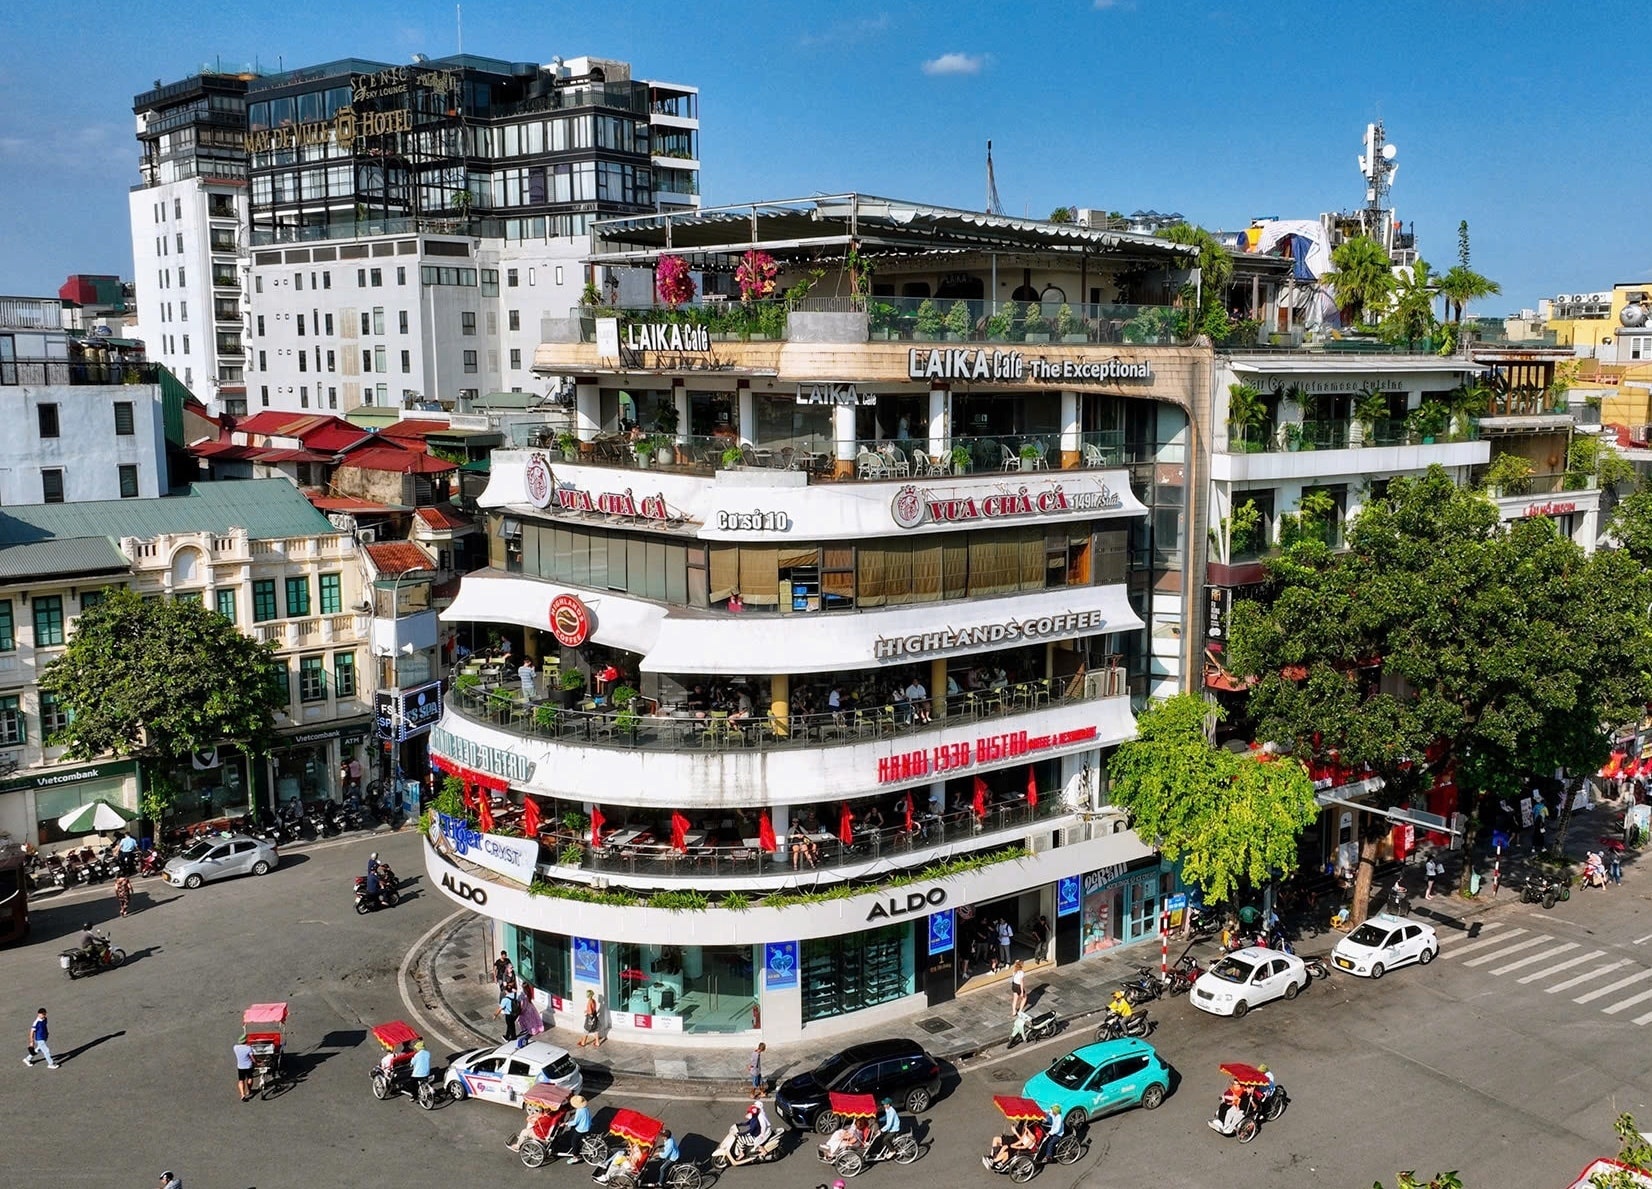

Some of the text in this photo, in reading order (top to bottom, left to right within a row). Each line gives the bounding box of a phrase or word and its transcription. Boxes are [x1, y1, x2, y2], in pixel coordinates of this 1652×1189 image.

[350, 66, 408, 91] SCENIC
[366, 84, 408, 99] SKY LOUNGE
[243, 108, 413, 154] MAY DE VILLE HOTEL
[628, 323, 709, 351] LAIKA Café
[908, 348, 1151, 381] LAIKA Café The Exceptional
[796, 383, 860, 405] LAIKA
[558, 488, 596, 513] VUA
[598, 487, 638, 517] CHẢ
[928, 496, 979, 522] VUA
[981, 485, 1034, 517] CHẢ
[765, 511, 787, 531] 10
[550, 598, 585, 623] HIGHLANDS
[555, 630, 583, 644] COFFEE
[875, 610, 1101, 658] HIGHLANDS COFFEE
[379, 717, 392, 728] SP
[381, 704, 393, 716] FS
[419, 701, 438, 719] SPA
[295, 730, 341, 743] Vietcombank
[344, 737, 360, 745] ATM
[481, 745, 529, 782] BISTRO
[878, 748, 929, 784] HANOI
[932, 741, 971, 773] 1930
[976, 730, 1028, 763] BISTRO
[37, 769, 99, 786] Vietcombank
[440, 813, 484, 855] Tiger
[441, 871, 487, 906] ALDO
[866, 887, 947, 922] ALDO
